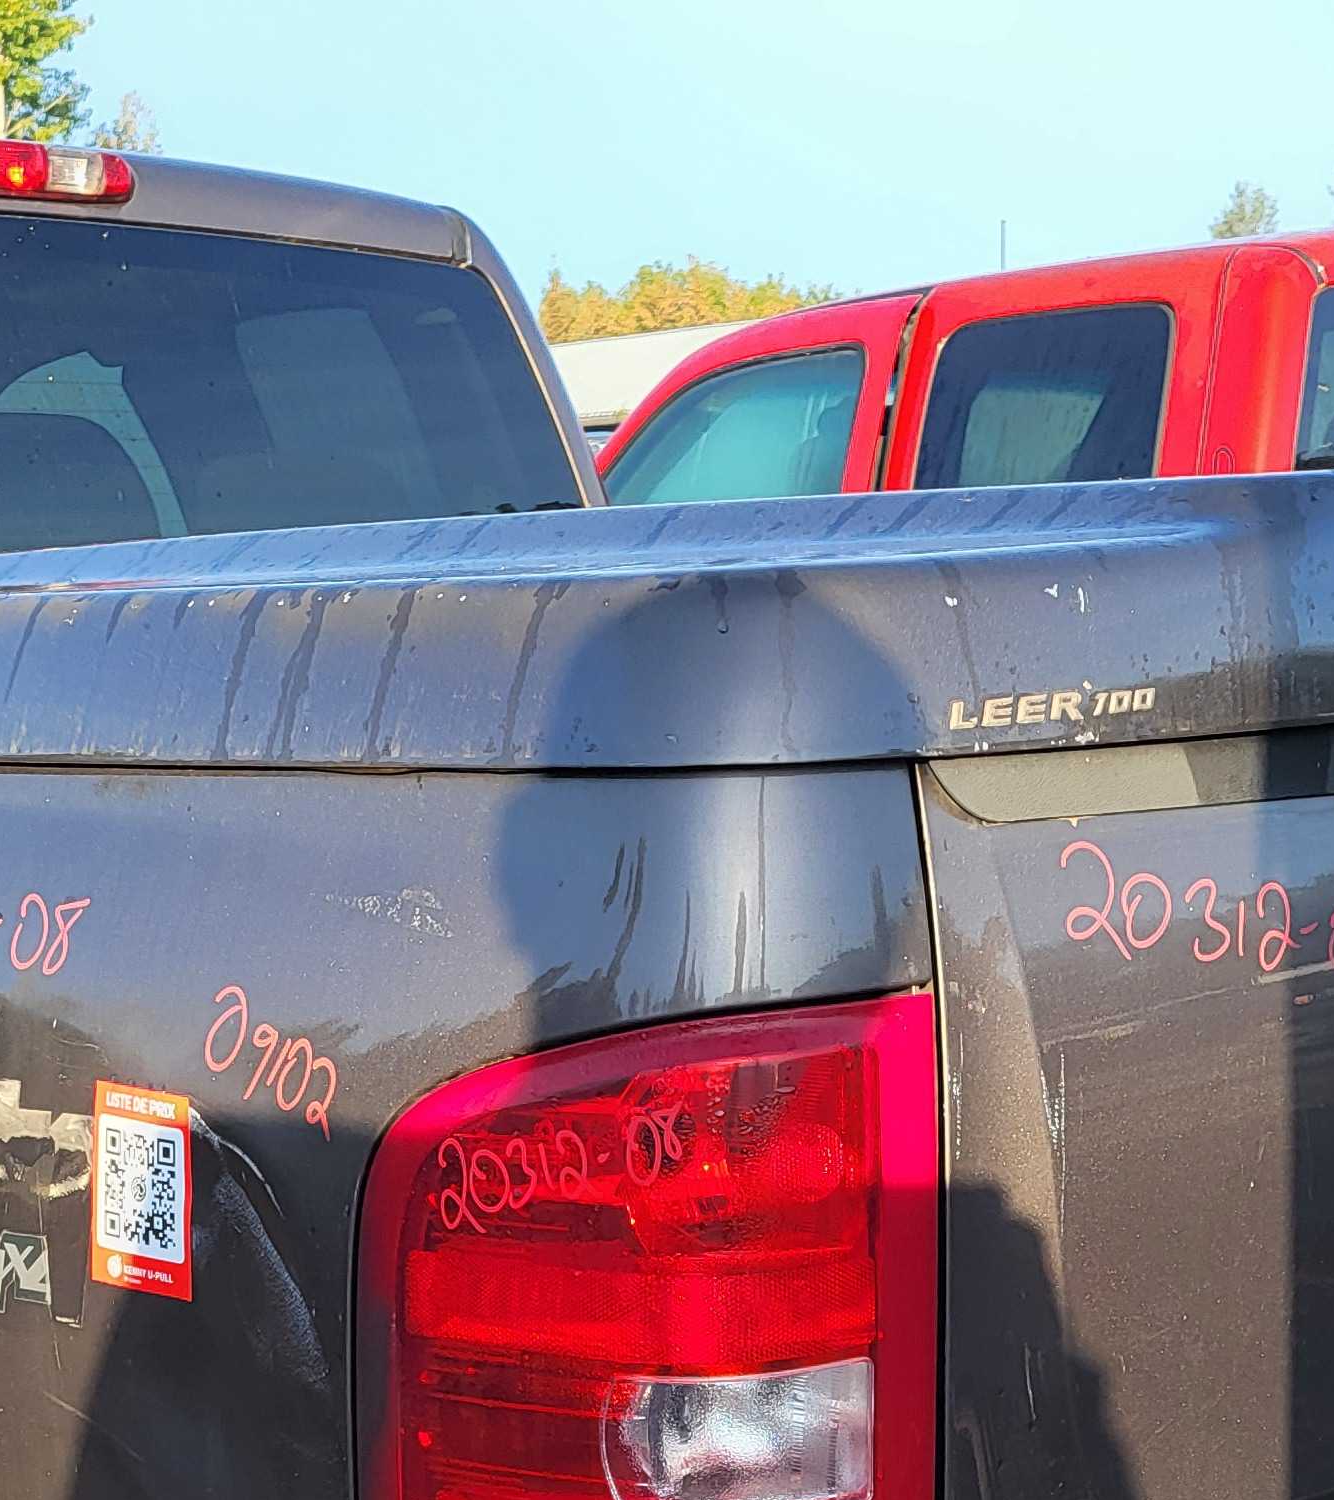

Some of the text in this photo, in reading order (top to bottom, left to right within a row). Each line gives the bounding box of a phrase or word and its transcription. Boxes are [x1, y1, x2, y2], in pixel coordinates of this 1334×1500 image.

[948, 687, 1084, 731] LEER
[105, 1090, 176, 1120] LISTE DE PRIX
[439, 1104, 683, 1234] 20312-08
